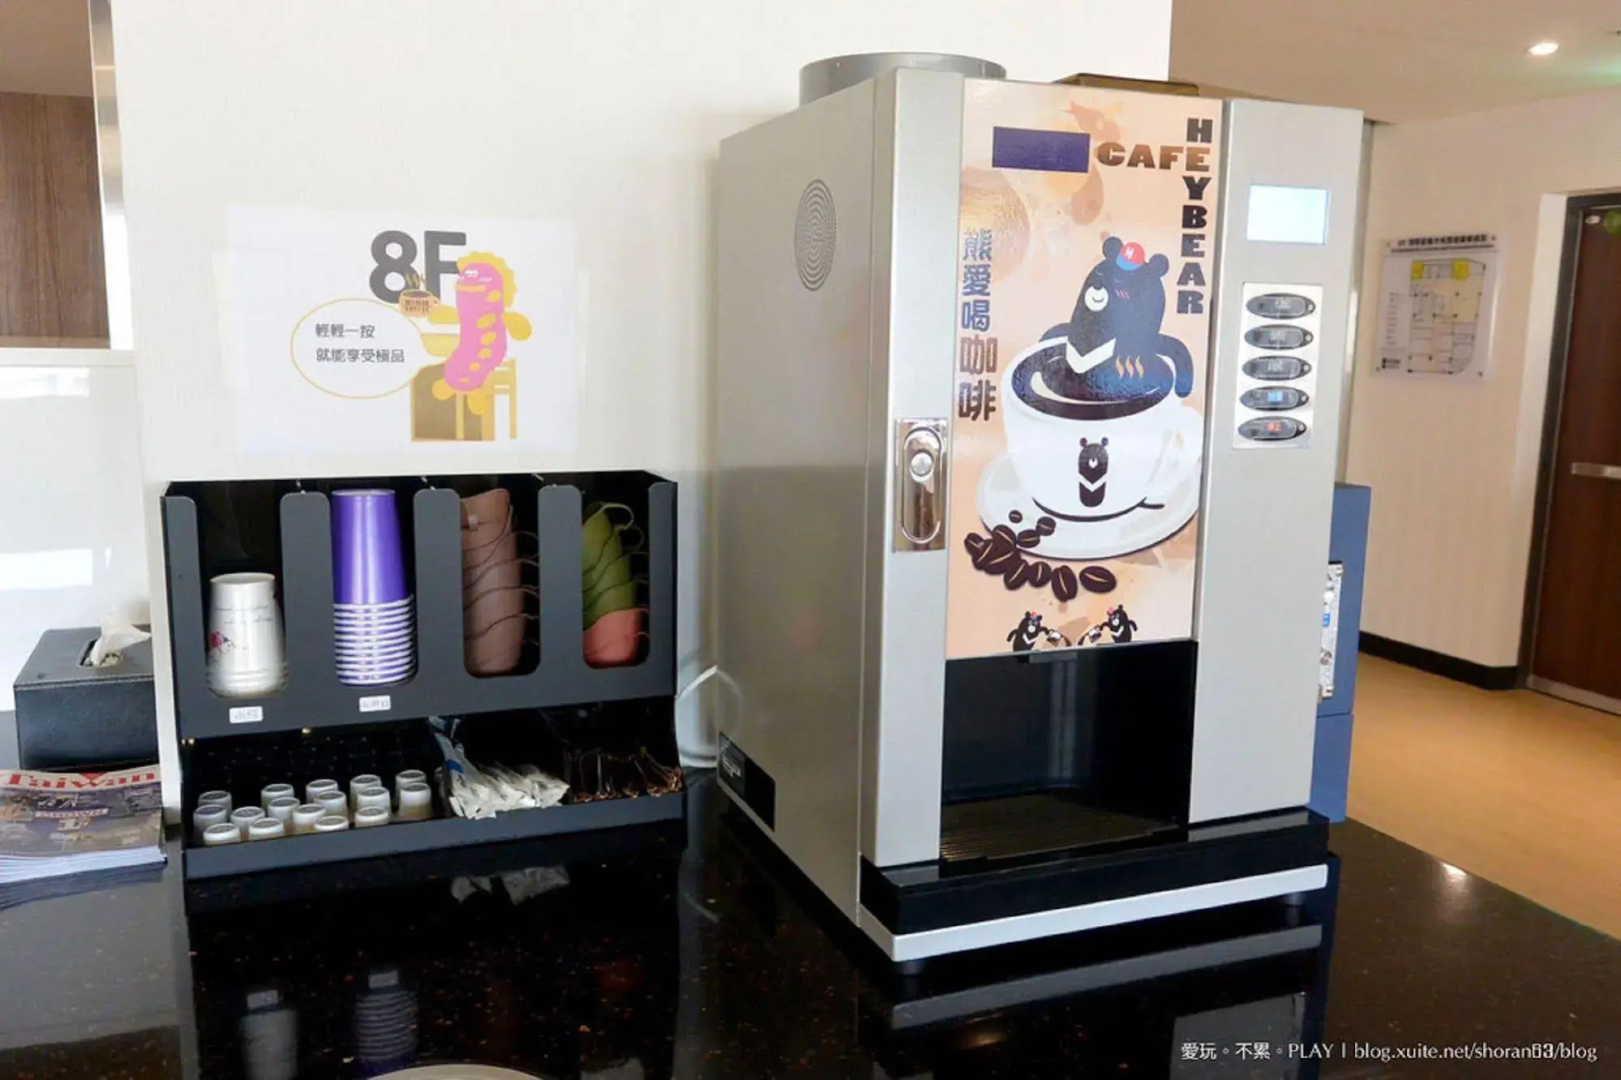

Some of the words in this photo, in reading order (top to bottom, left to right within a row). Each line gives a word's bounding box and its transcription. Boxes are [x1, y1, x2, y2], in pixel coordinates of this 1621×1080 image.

[368, 230, 467, 305] 8F
[315, 323, 376, 339] 輕輕一按
[958, 228, 998, 422] 熊愛喝咖啡
[316, 347, 405, 363] 就能享受極品
[8, 772, 156, 789] Taiwan
